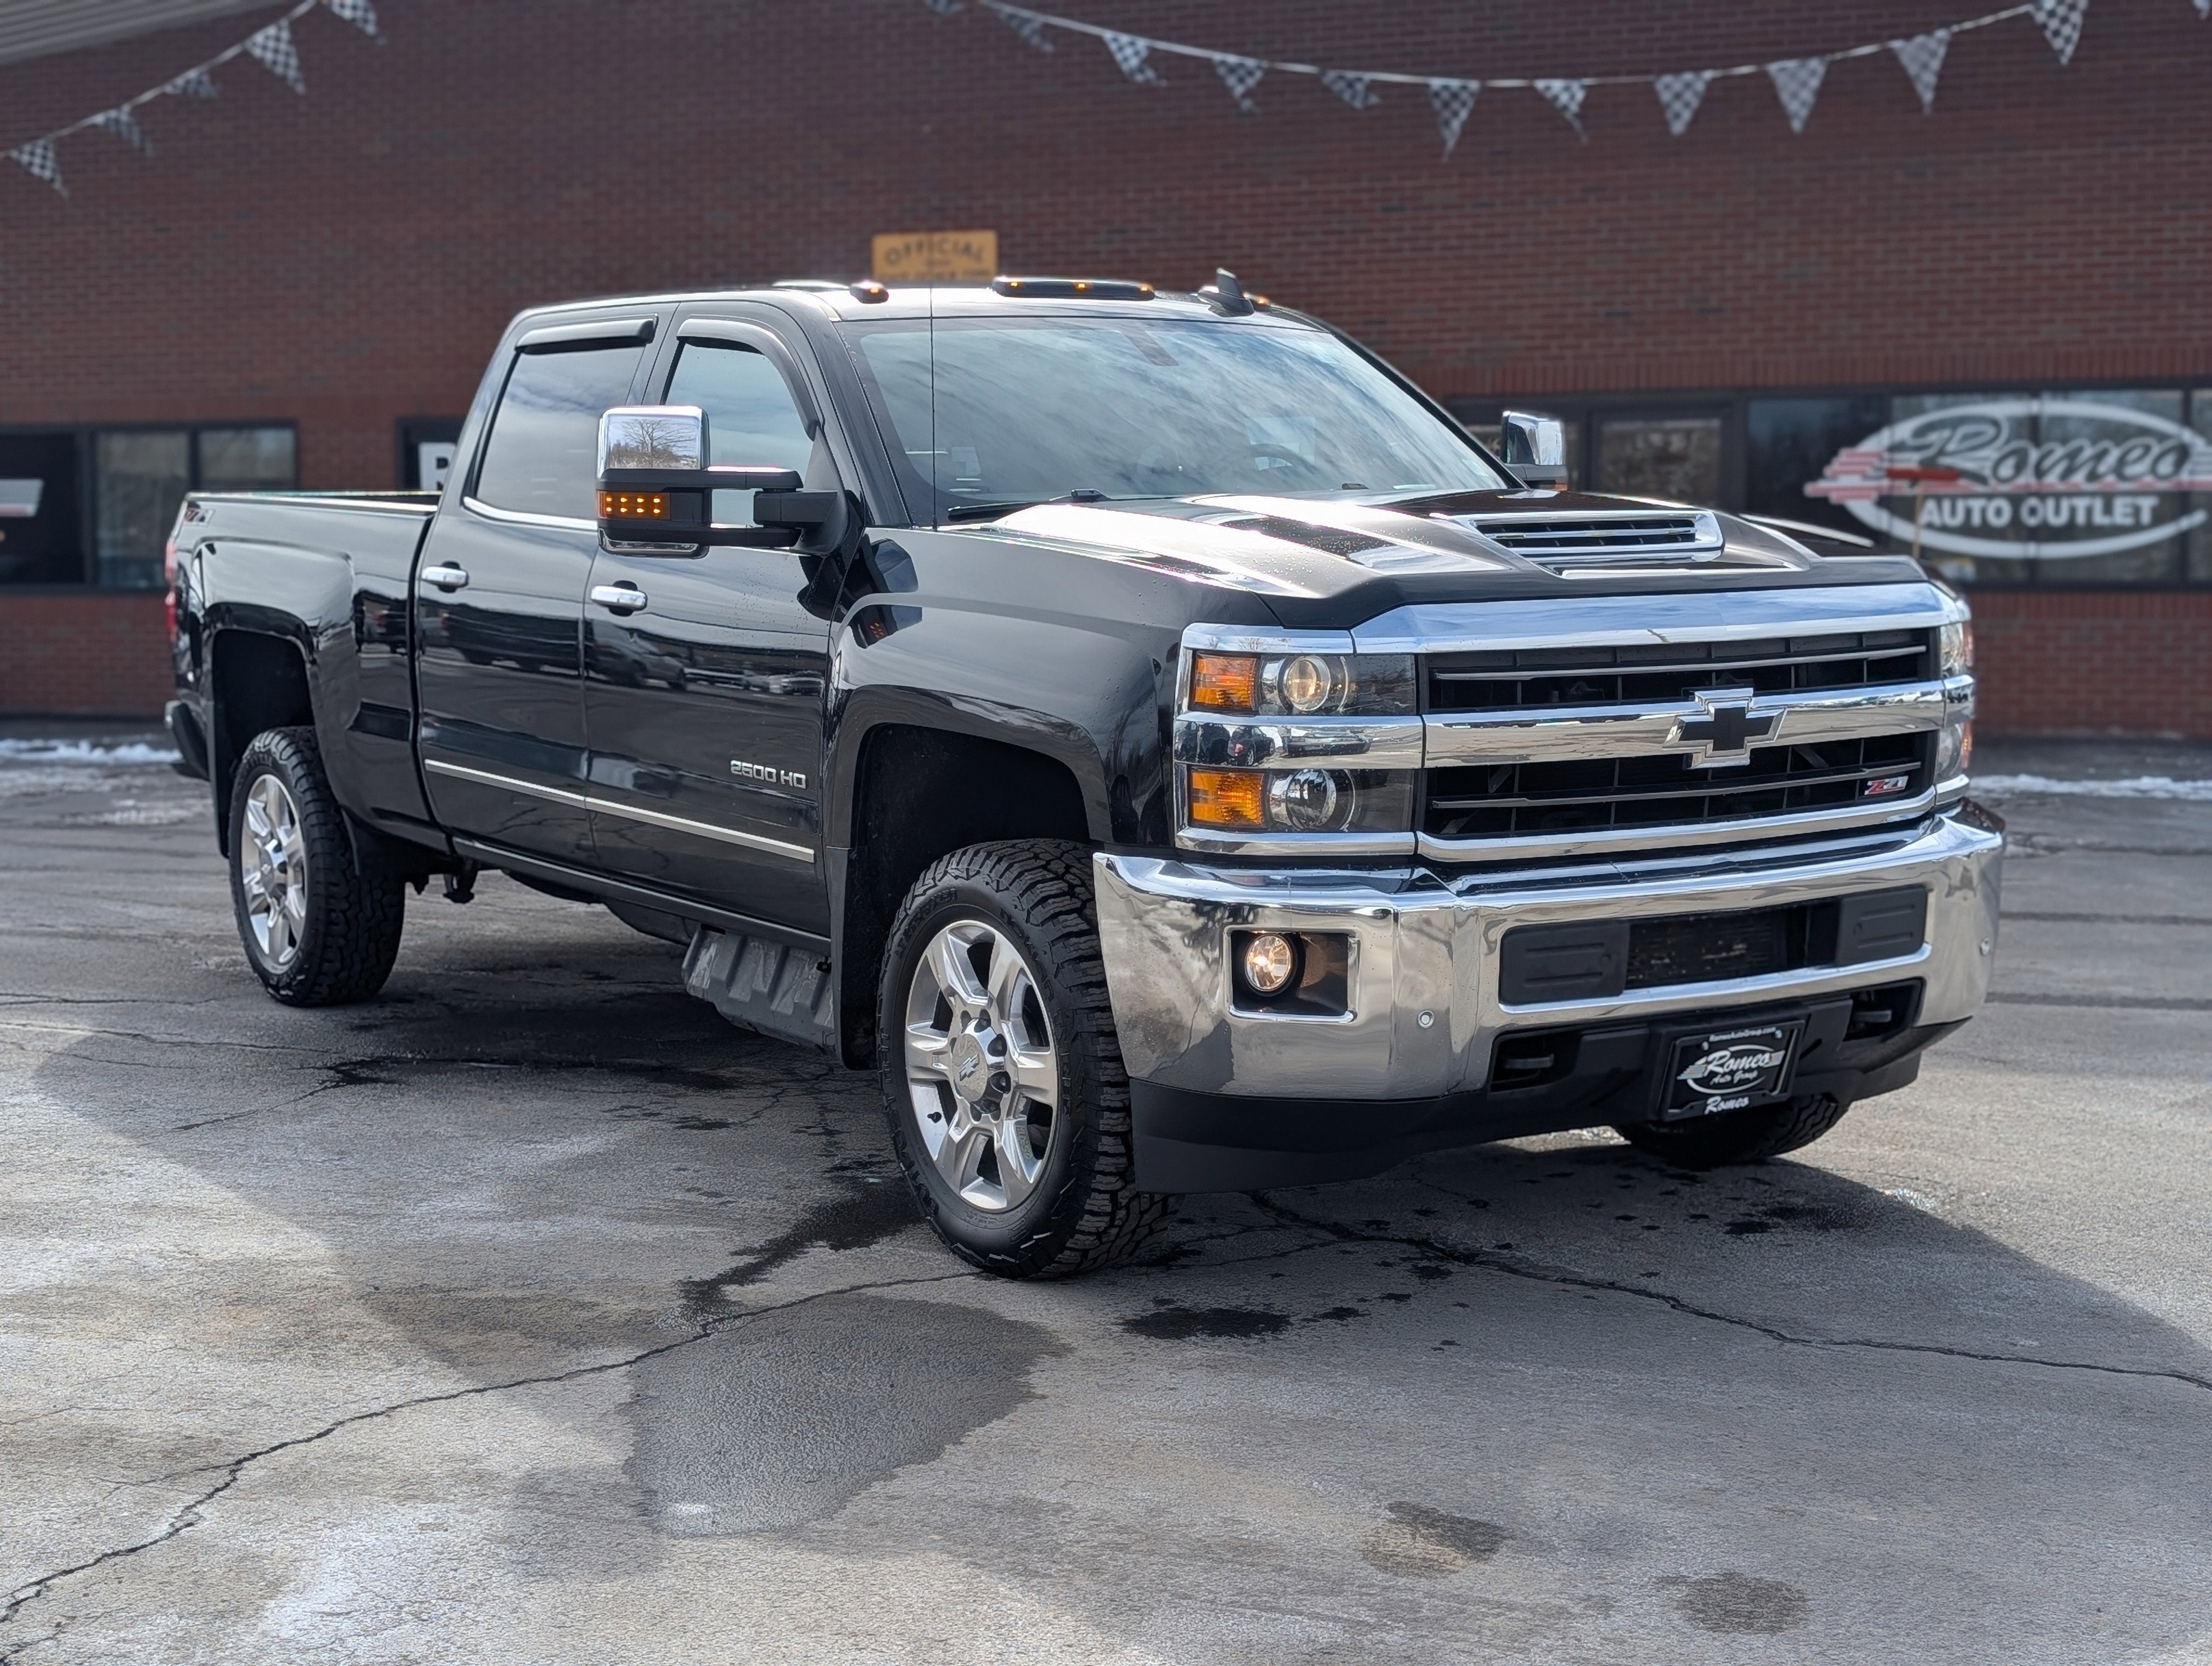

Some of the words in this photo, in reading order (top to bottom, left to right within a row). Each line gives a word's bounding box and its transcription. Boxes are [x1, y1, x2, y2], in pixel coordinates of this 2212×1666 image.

[1886, 413, 2191, 486] Romeo
[1920, 496, 2012, 527] AUTO
[2021, 496, 2160, 528] OUTLET
[731, 760, 777, 783] 2500
[780, 770, 806, 789] HD
[1864, 776, 1909, 796] Z71
[1704, 1050, 1771, 1077] Romeo
[1704, 1095, 1750, 1115] Romeo
